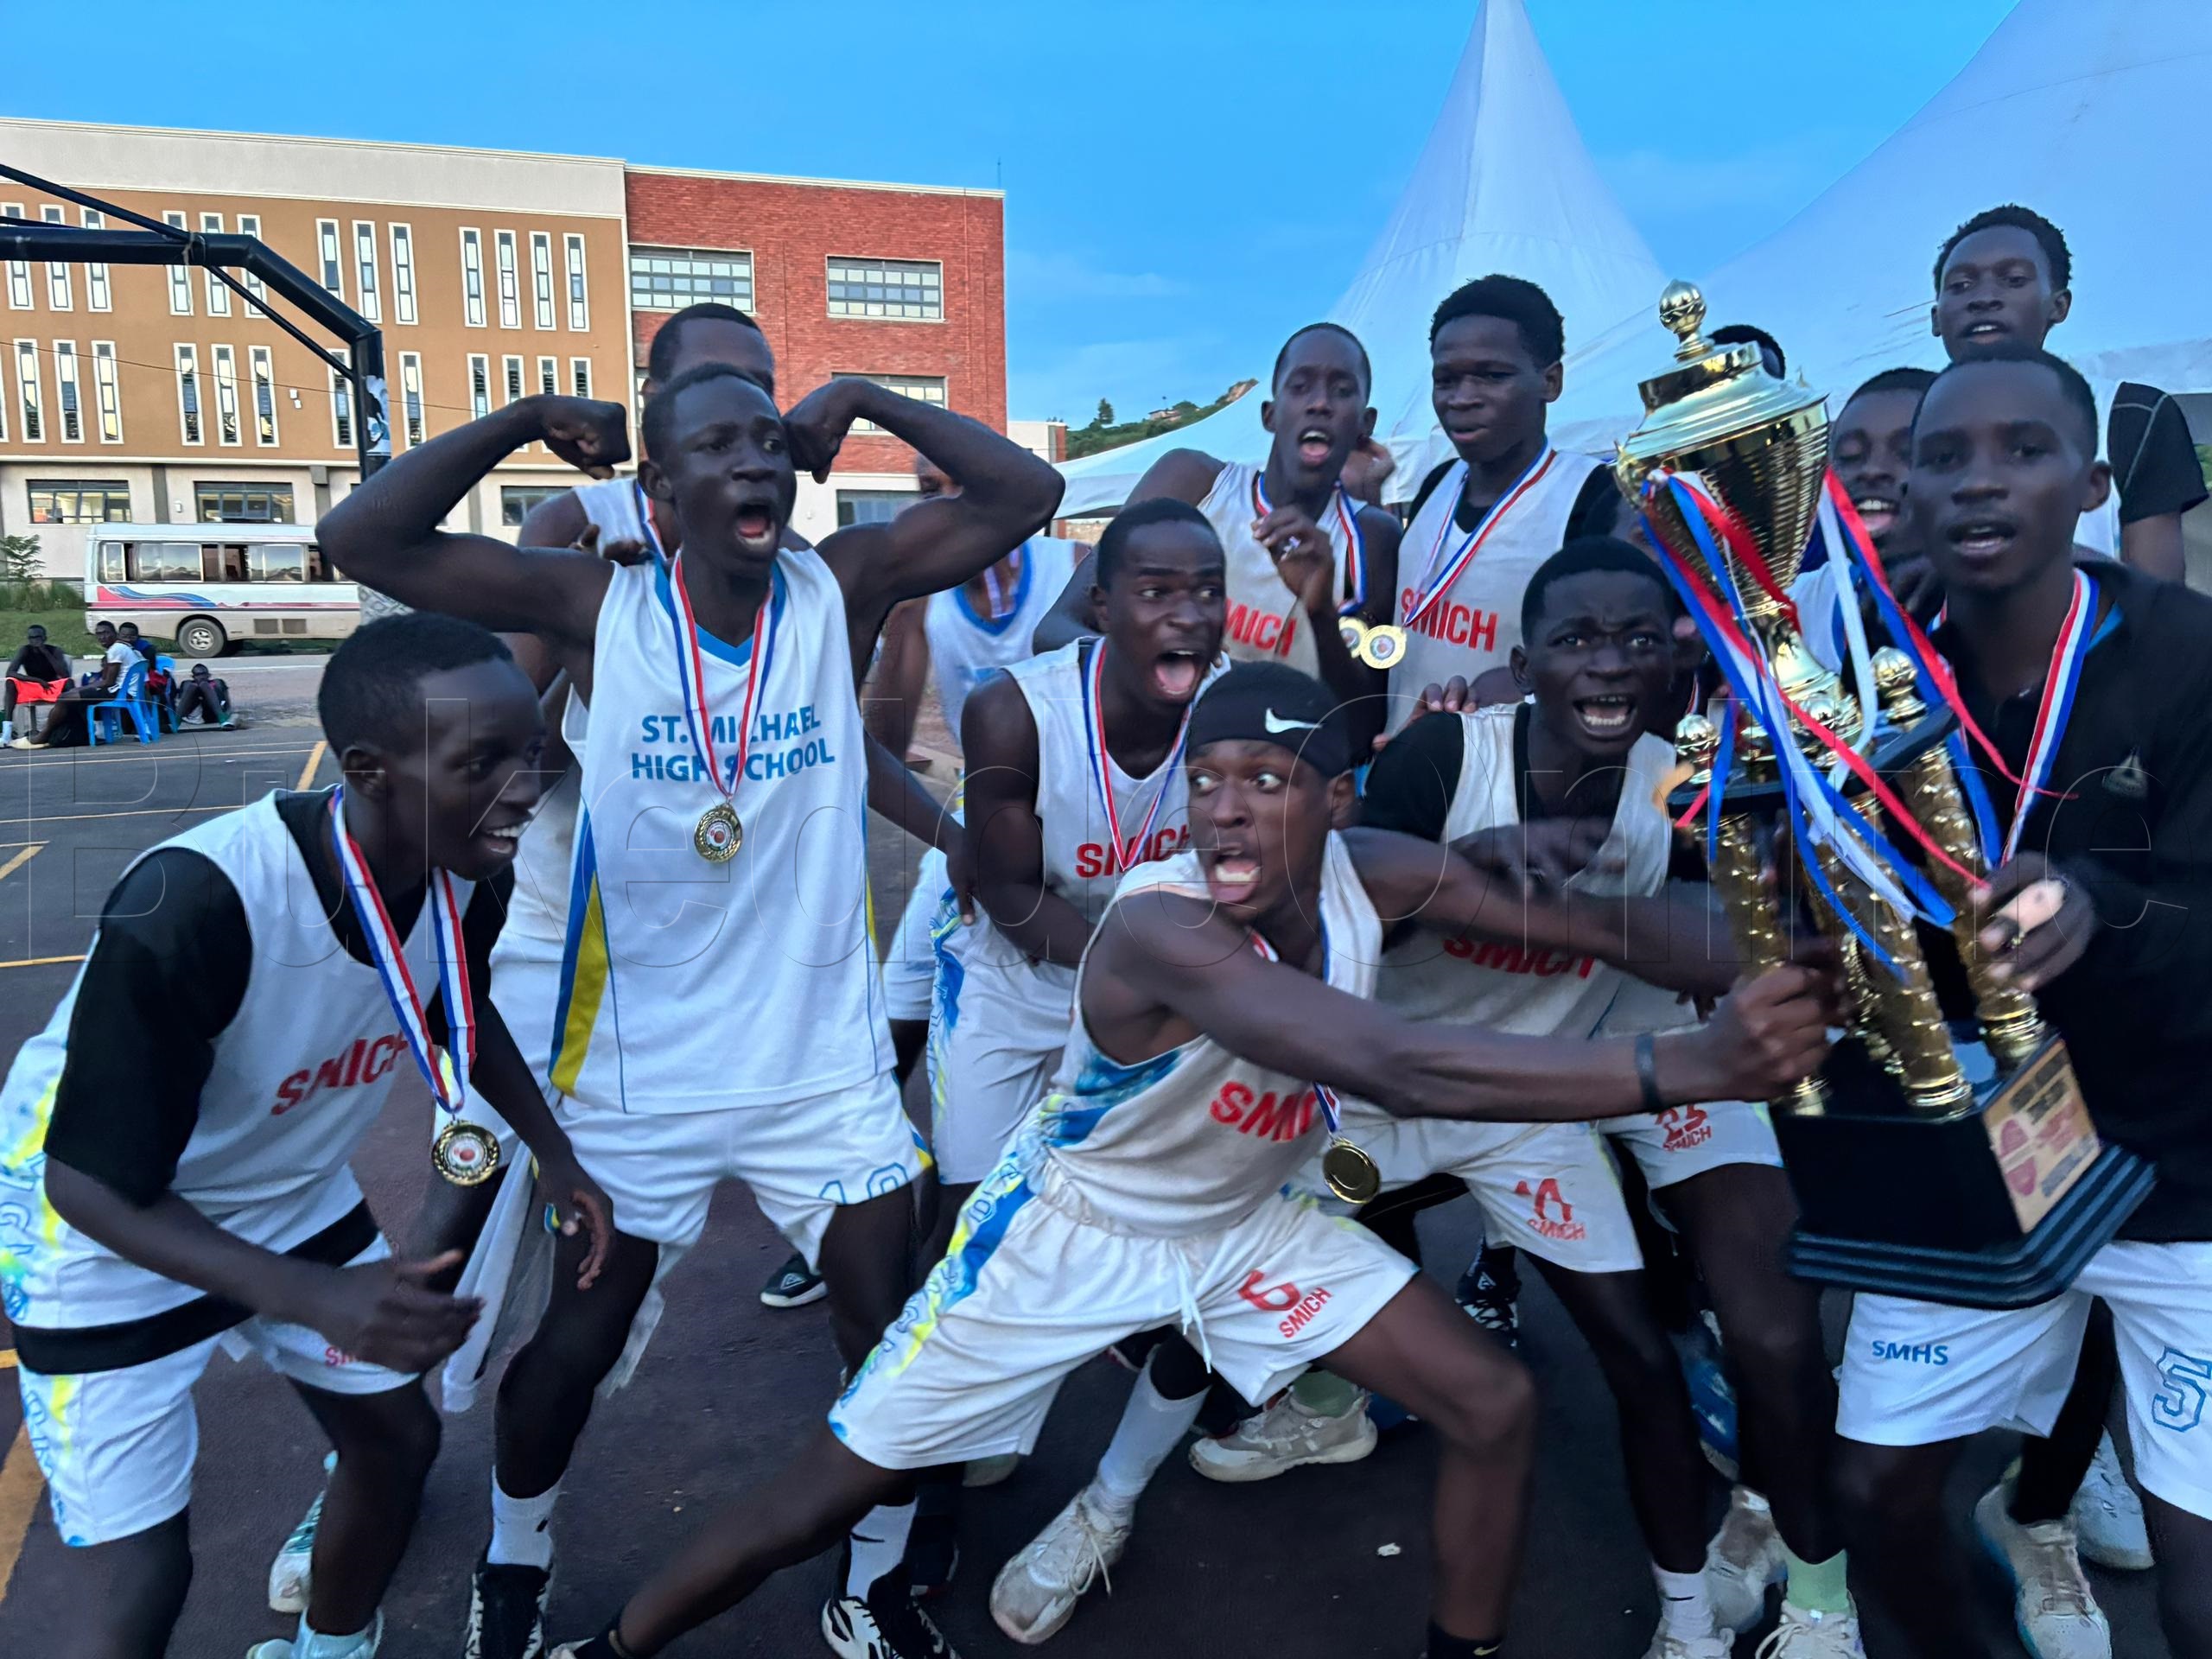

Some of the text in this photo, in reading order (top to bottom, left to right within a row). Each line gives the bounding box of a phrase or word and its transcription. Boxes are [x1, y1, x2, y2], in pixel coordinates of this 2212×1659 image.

[641, 715, 690, 744] ST.
[1237, 1268, 1300, 1312] 6
[1279, 1287, 1332, 1338] SMICH
[1872, 1340, 1948, 1365] SMHS
